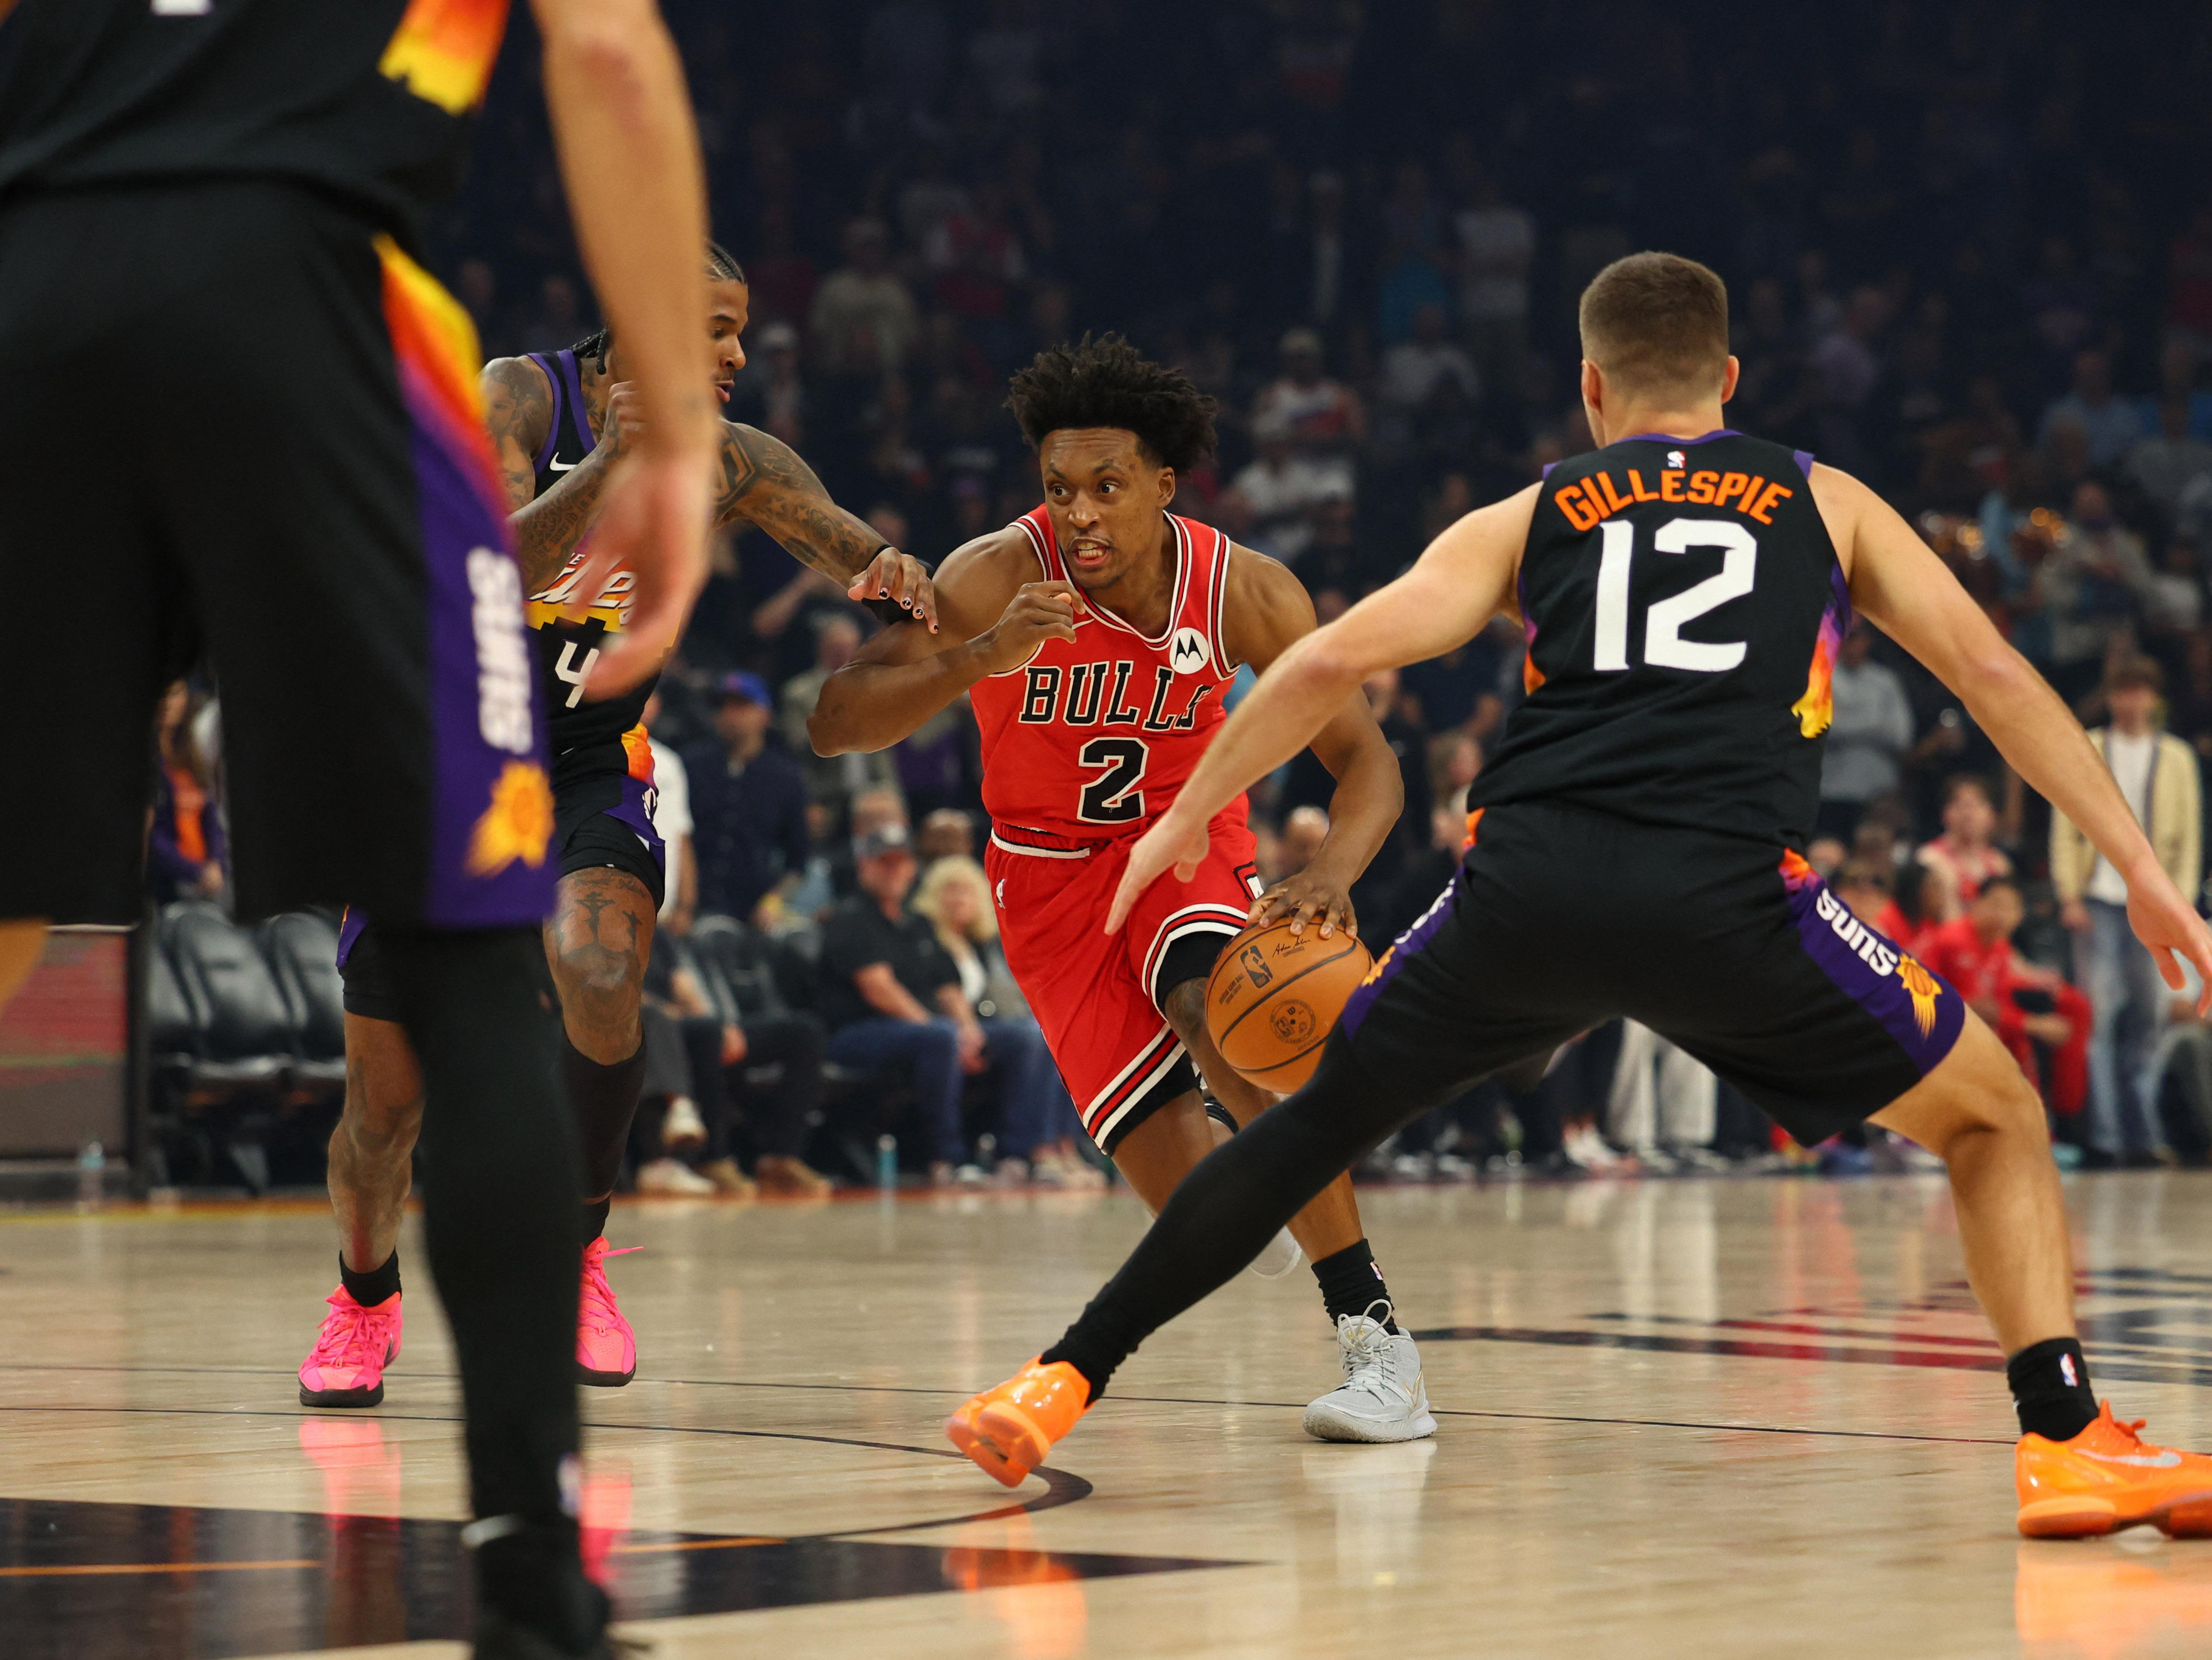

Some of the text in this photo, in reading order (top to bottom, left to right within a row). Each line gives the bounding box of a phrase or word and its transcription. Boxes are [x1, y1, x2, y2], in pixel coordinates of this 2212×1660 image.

[1554, 469, 1793, 531] GILLESPIE
[1594, 518, 1757, 671] 12
[555, 639, 600, 708] 4
[1018, 660, 1216, 731] BULLS
[1077, 737, 1149, 824] 2
